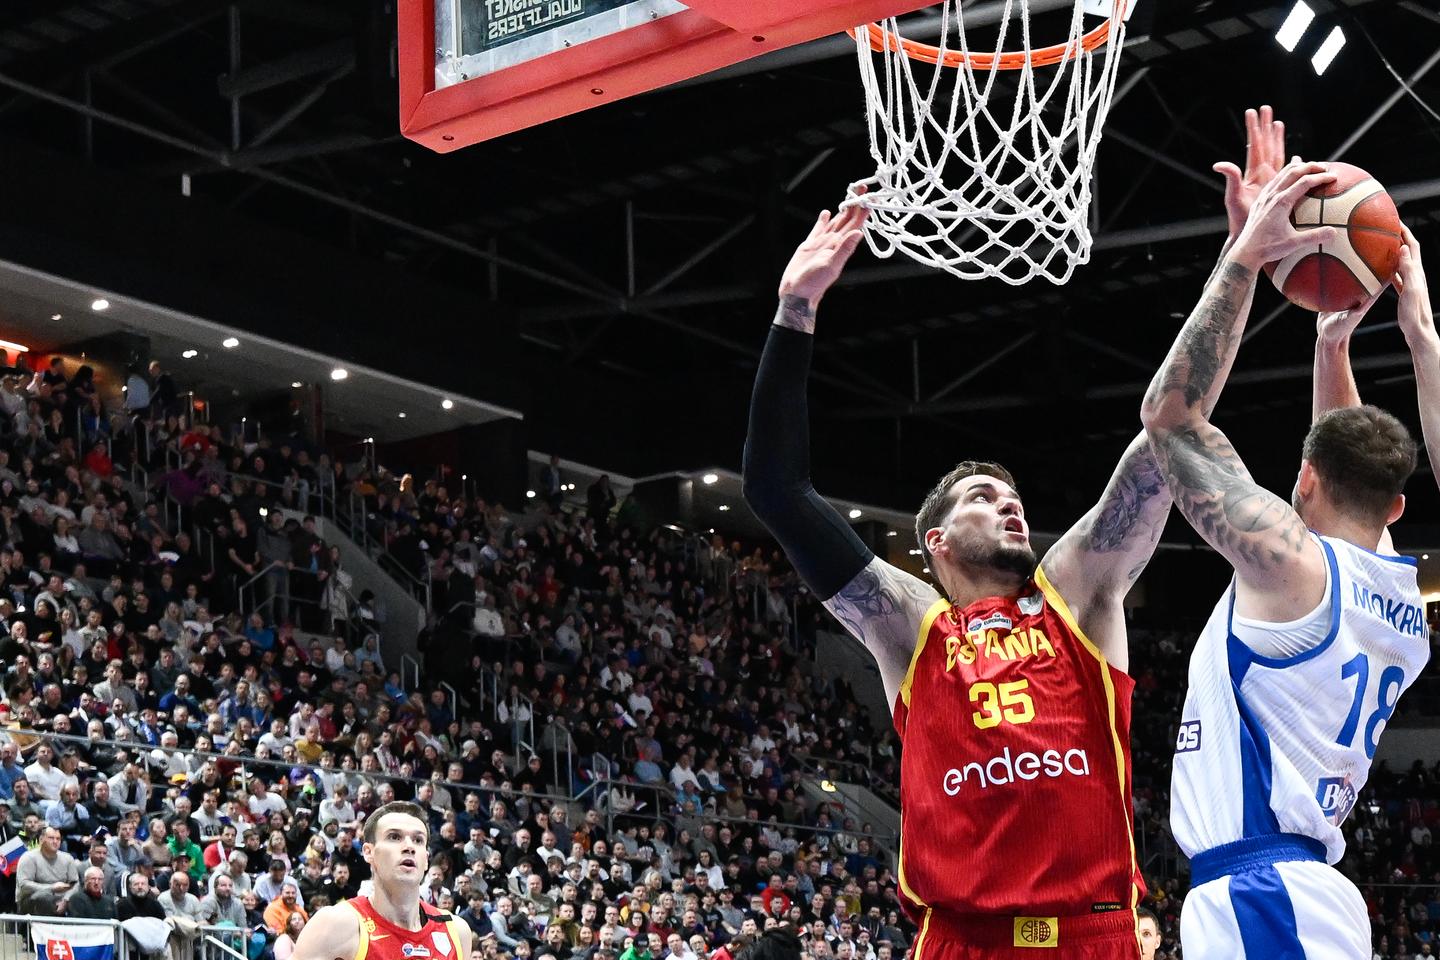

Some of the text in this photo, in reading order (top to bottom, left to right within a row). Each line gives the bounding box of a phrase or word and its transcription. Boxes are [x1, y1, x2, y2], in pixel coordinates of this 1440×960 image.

[945, 627, 1056, 673] ESPAÑA
[968, 678, 1037, 730] 35
[1335, 652, 1405, 760] 18
[943, 746, 1091, 797] endesa
